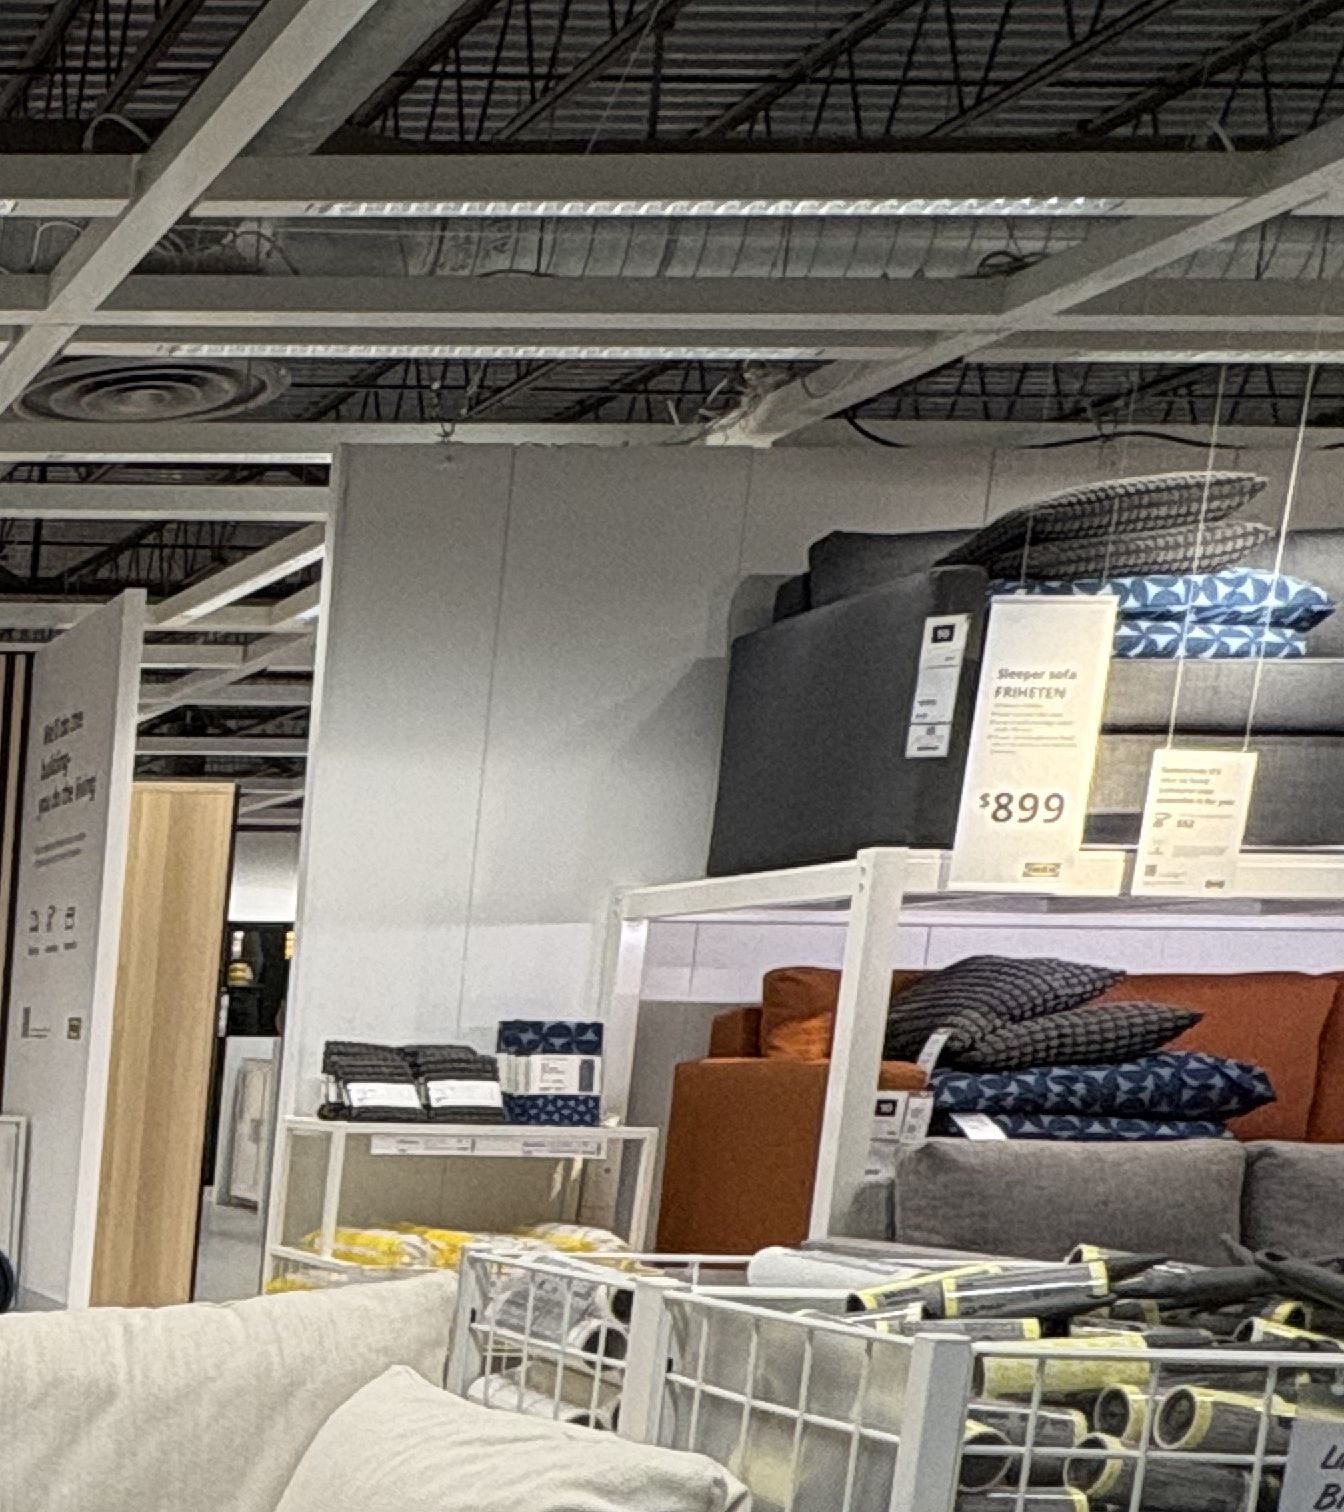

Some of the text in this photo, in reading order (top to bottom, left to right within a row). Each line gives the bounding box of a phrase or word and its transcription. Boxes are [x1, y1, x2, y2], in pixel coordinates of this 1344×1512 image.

[996, 668, 1078, 682] Sleeper sofa
[994, 686, 1067, 700] FRIHETEN
[978, 792, 1065, 823] $899
